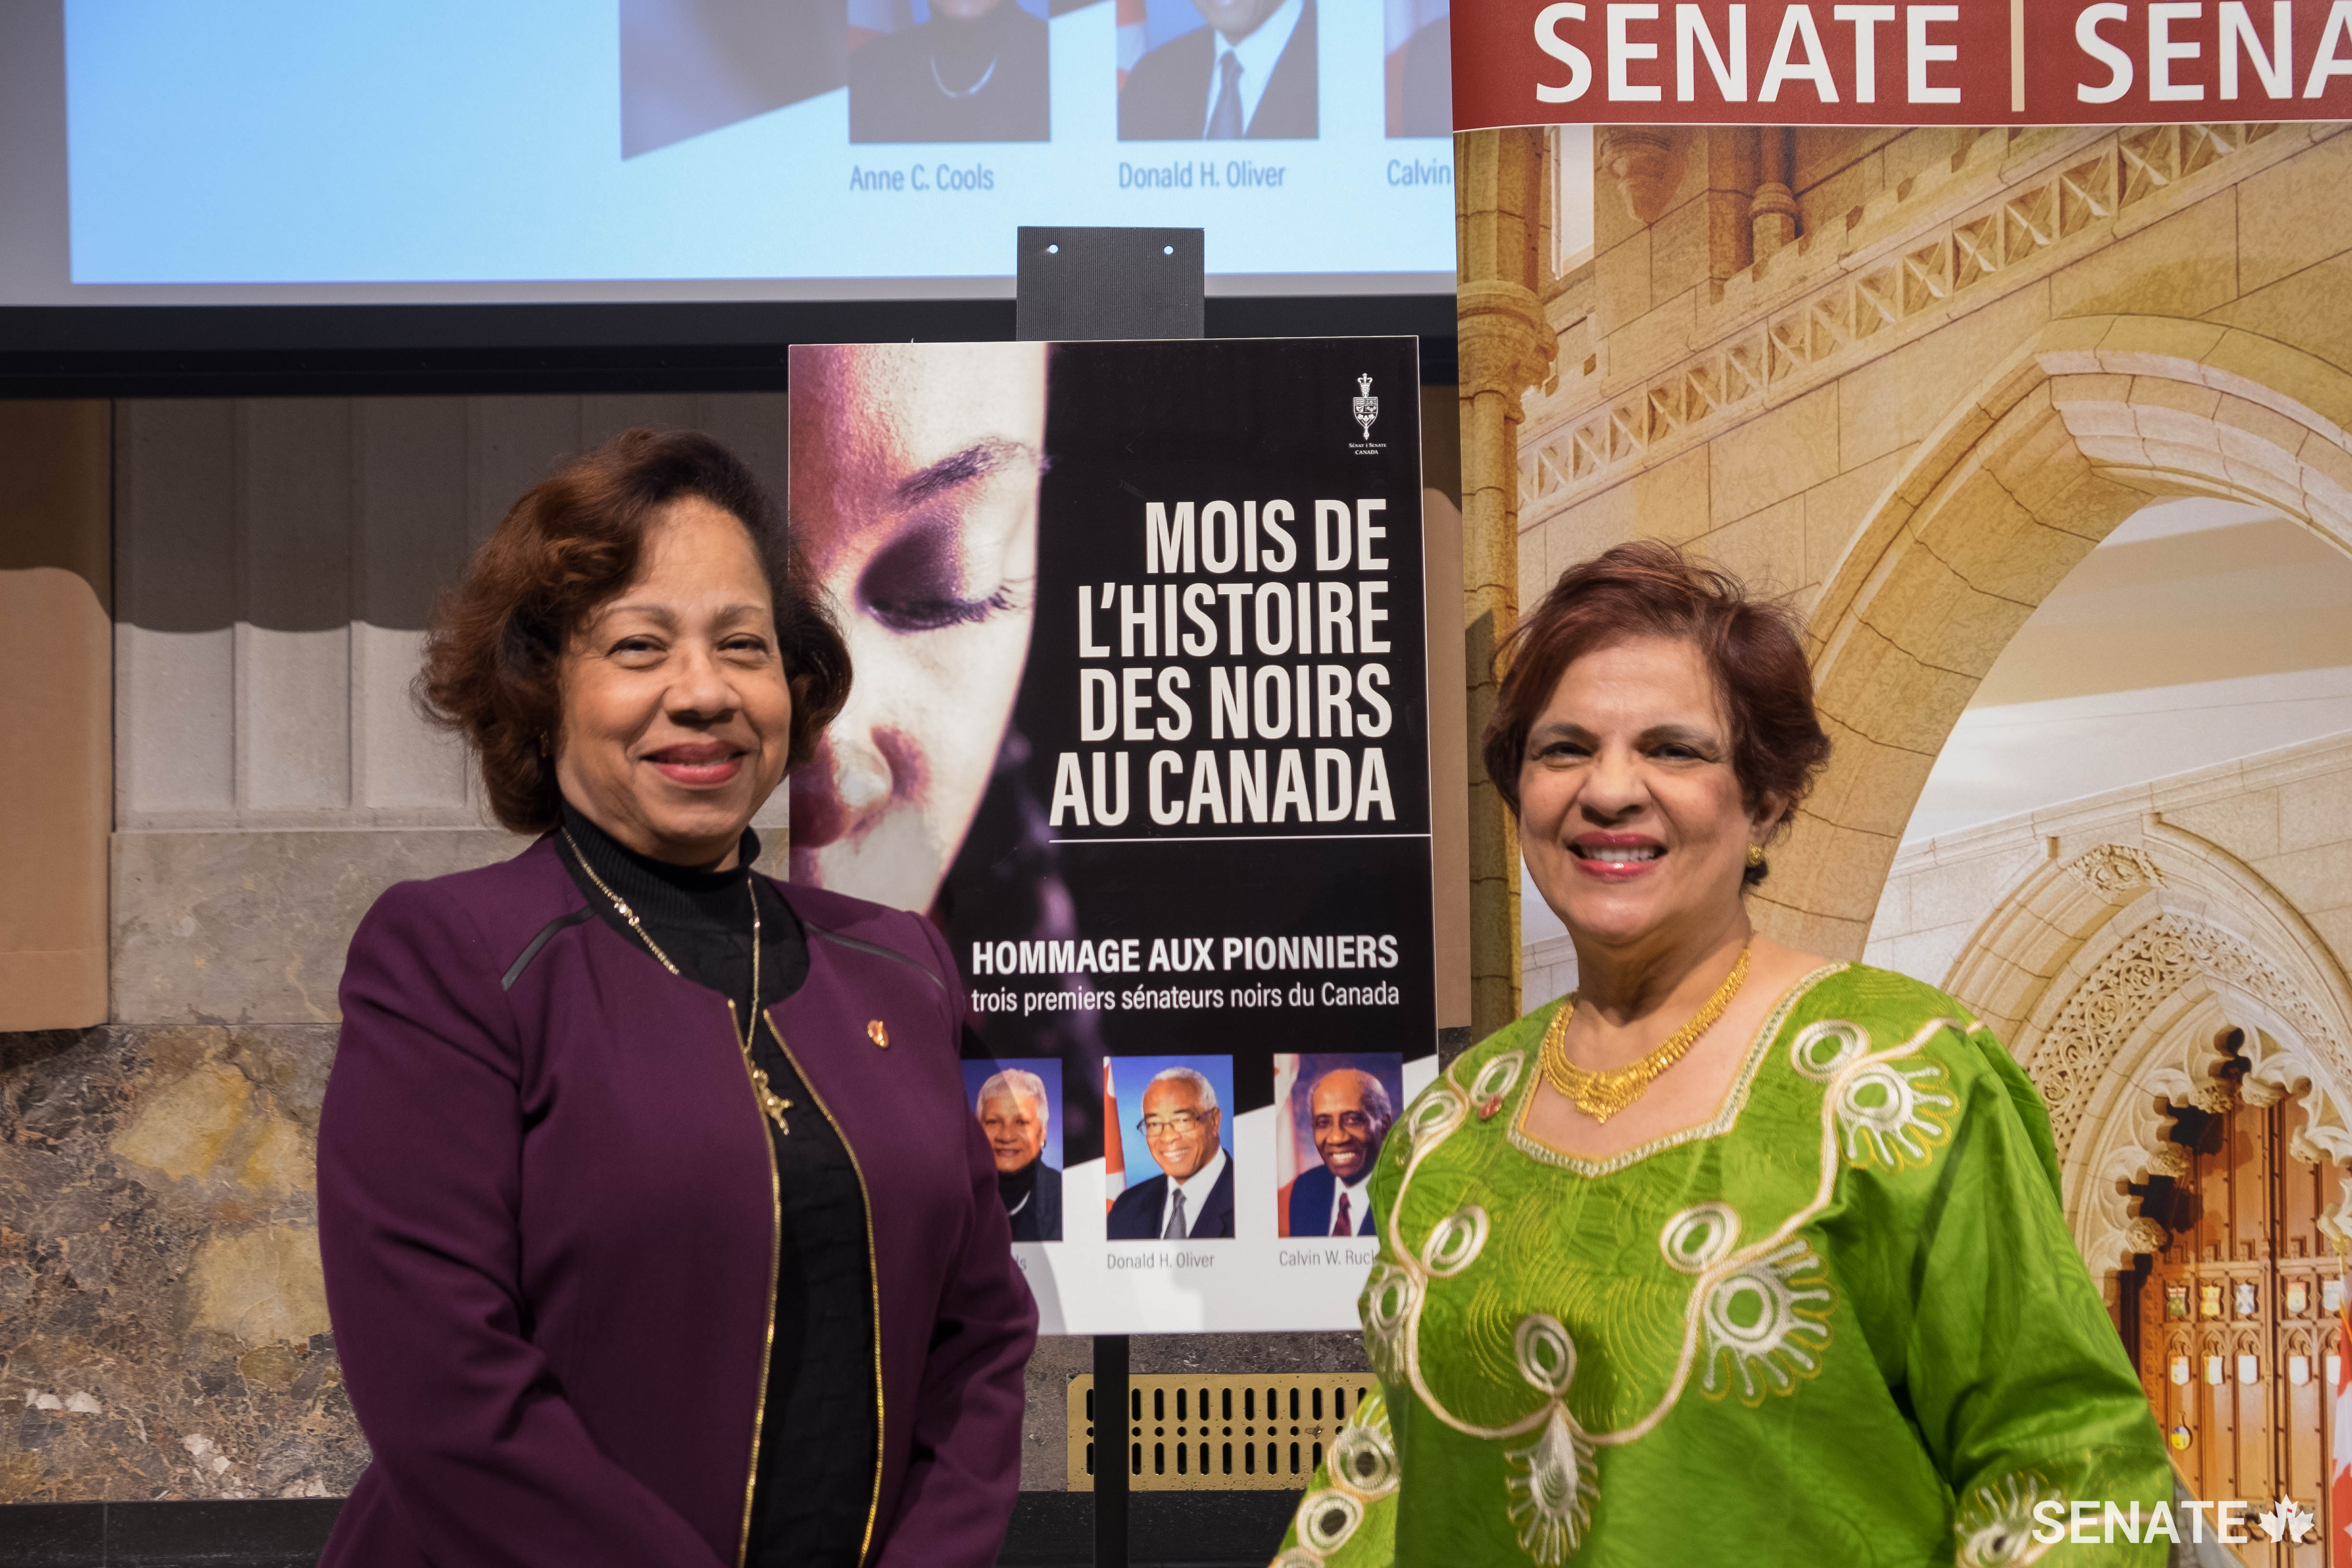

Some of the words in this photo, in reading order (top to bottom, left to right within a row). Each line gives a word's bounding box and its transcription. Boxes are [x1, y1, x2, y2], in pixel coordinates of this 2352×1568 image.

[1534, 2, 1960, 103] SENATE
[849, 164, 904, 191] Anne
[911, 163, 930, 191] C.
[936, 162, 994, 191] Cools
[1119, 161, 1192, 189] Donald
[1200, 162, 1220, 188] H.
[1226, 159, 1286, 188] Oliver
[1387, 158, 1451, 186] Calvin
[1146, 499, 1297, 573] MOIS
[1314, 499, 1389, 571] DE
[1078, 581, 1391, 658] L'HISTOIRE
[1080, 666, 1192, 741] DES
[1210, 663, 1392, 739] NOIRS
[1049, 751, 1129, 827] AU
[1148, 747, 1396, 825] CANADA
[972, 939, 1140, 975] HOMMAGE
[1149, 937, 1215, 972] AUX
[1223, 934, 1398, 970] PIONNIERS
[971, 986, 1017, 1012] trois
[1024, 985, 1116, 1017] premiers
[1122, 983, 1224, 1010] sénateurs
[1231, 982, 1282, 1007] noirs
[1289, 981, 1314, 1007] du
[1322, 980, 1399, 1006] Canada
[1107, 1253, 1153, 1269] Donald
[1159, 1253, 1172, 1268] H.
[1176, 1251, 1215, 1268] Oliver
[1279, 1250, 1321, 1266] Calvin
[1325, 1250, 1341, 1265] W.
